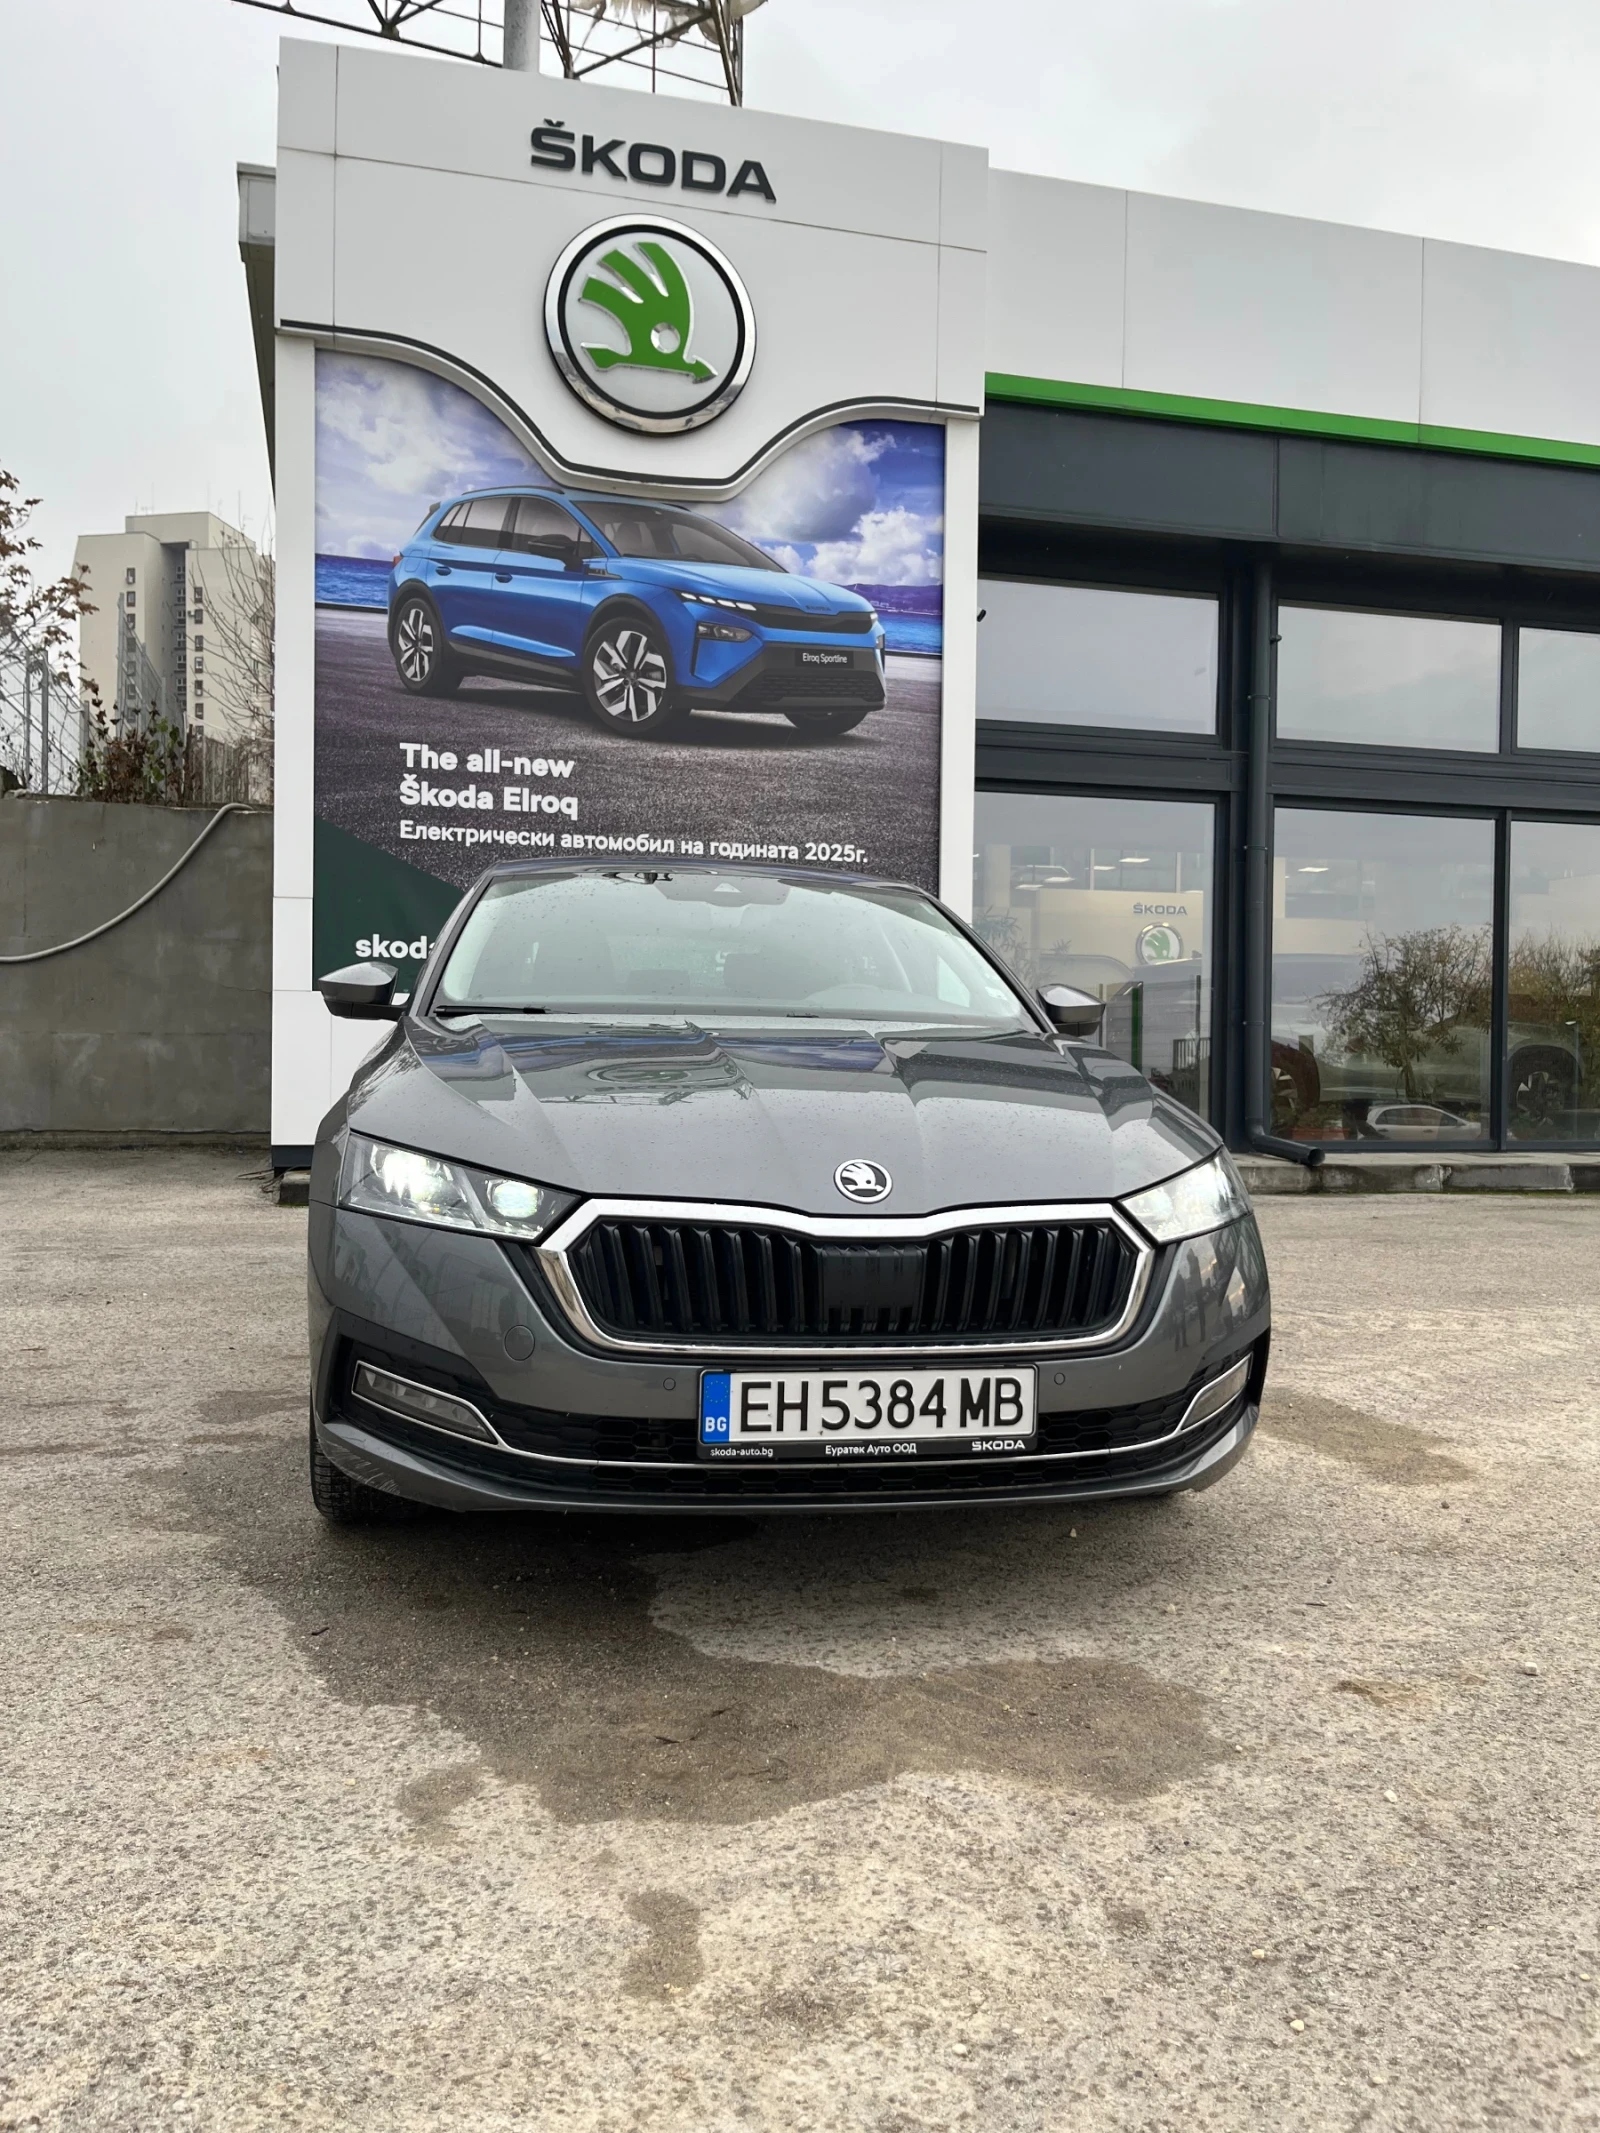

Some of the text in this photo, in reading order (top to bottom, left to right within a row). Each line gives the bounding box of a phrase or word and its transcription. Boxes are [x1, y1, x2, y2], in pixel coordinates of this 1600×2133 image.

[530, 118, 777, 204] ŠKODA
[802, 652, 847, 664] Elroq Sportline
[399, 742, 575, 778] The all-new
[399, 773, 578, 821] Škoda Elroq
[399, 819, 868, 863] Електрически автомобил на годината 2025г.
[1132, 902, 1188, 916] ŠKODA
[355, 933, 436, 959] skod
[705, 1416, 728, 1433] BG
[710, 1447, 774, 1458] skoda-auto.bg
[825, 1442, 917, 1457] Еуратек Ауто ООД
